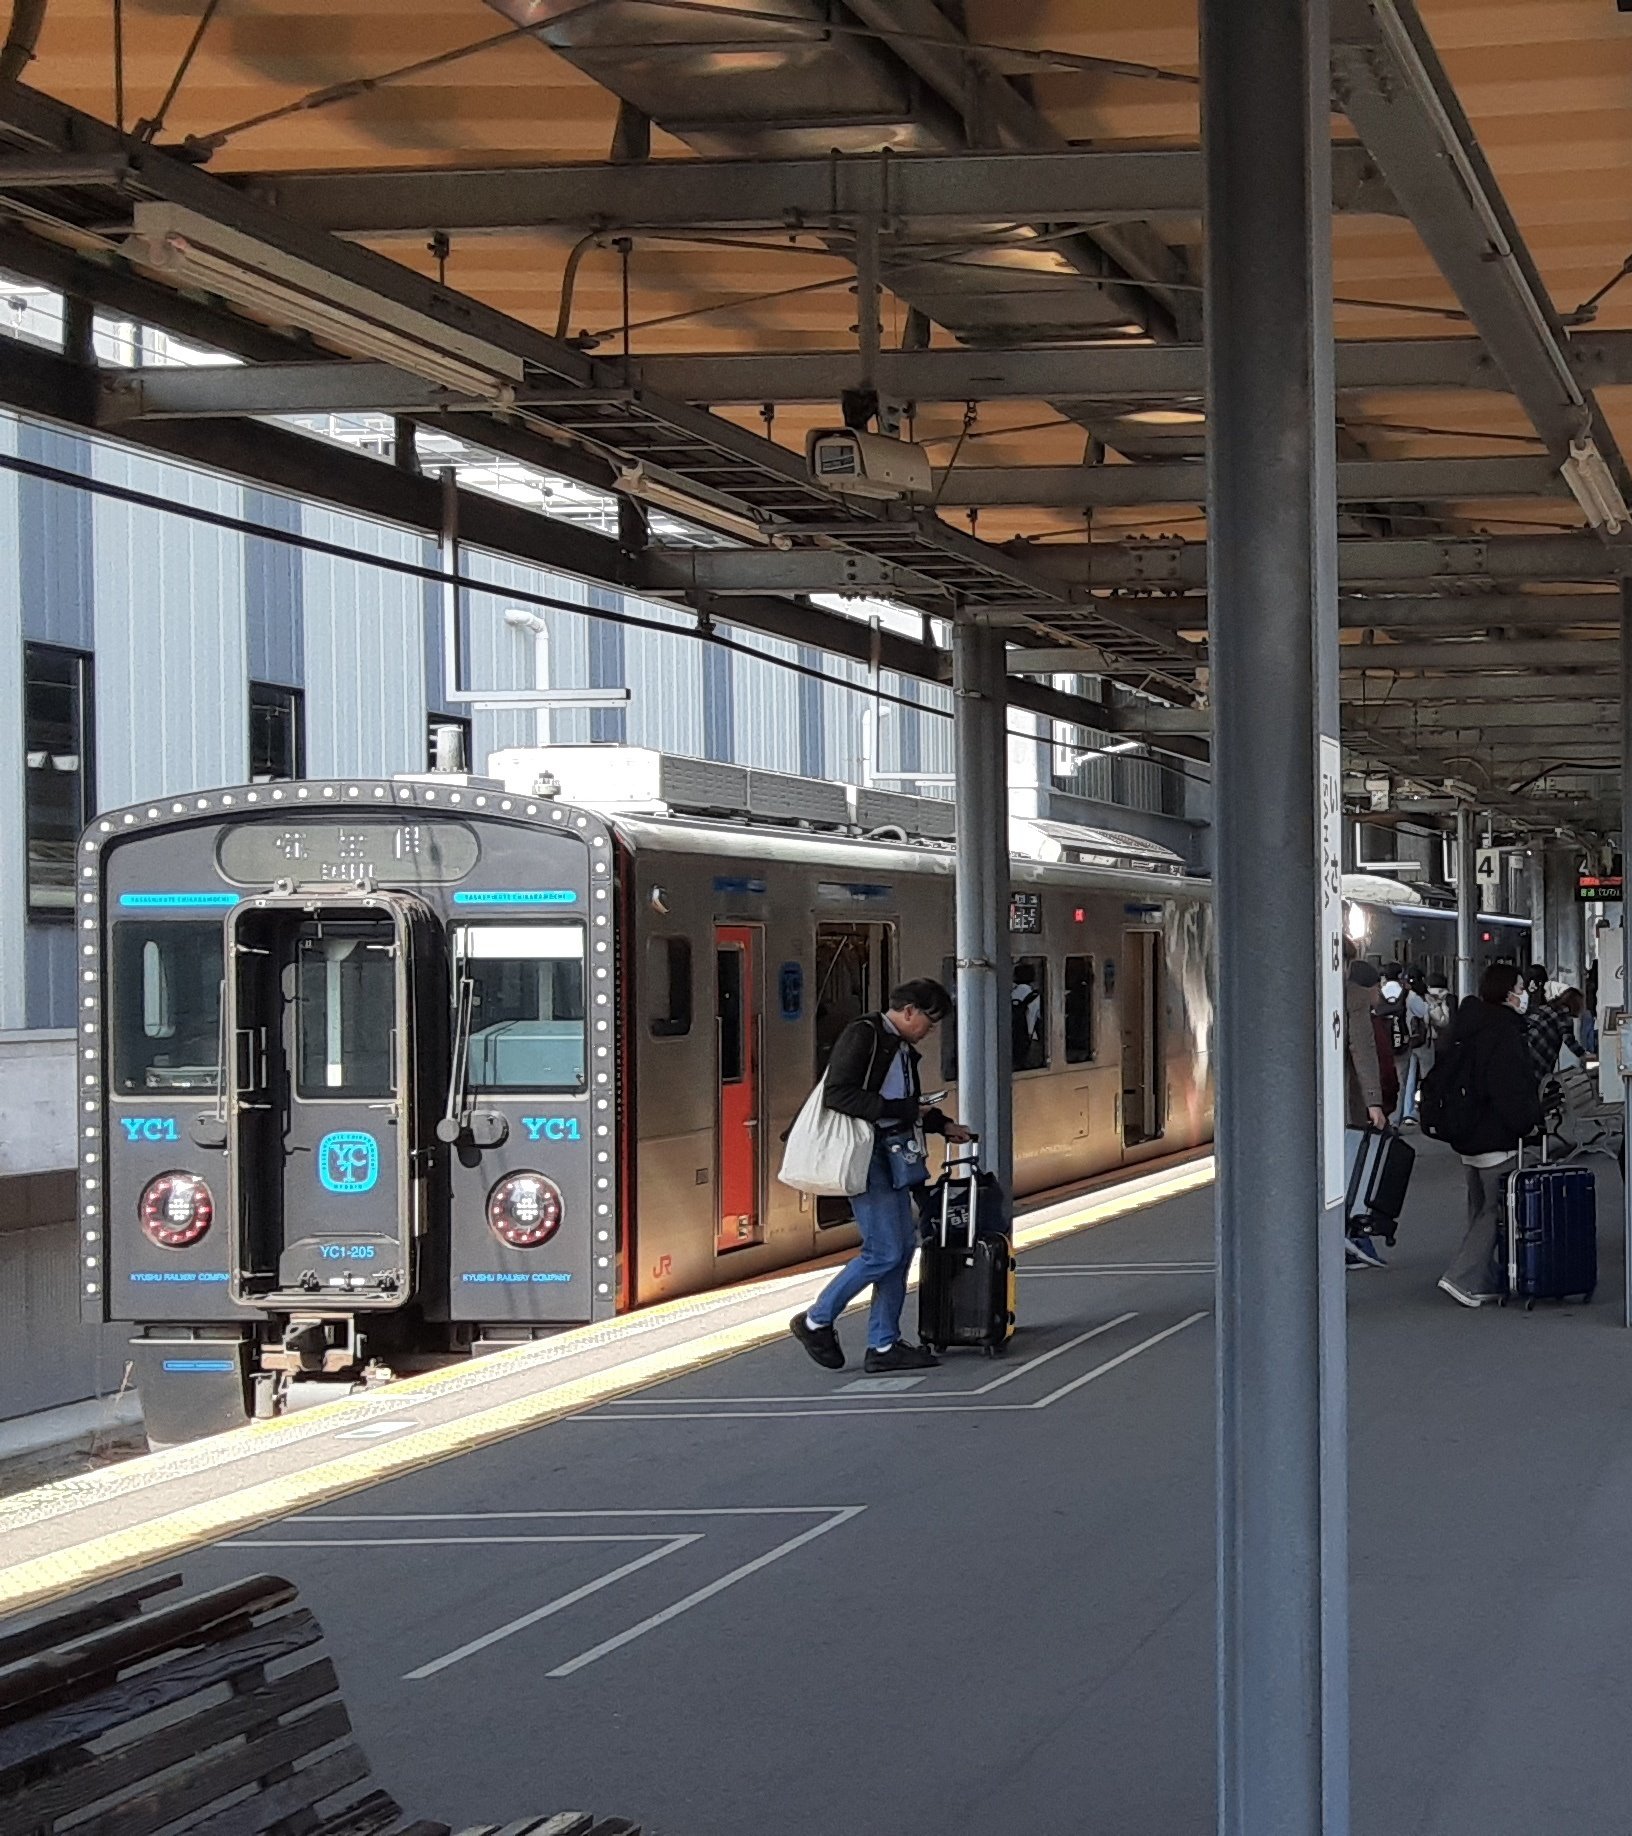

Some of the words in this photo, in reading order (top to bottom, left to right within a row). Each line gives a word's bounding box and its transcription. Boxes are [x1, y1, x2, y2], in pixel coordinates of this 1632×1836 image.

[1478, 855, 1494, 878] 4
[1330, 775, 1340, 1051] いさはや
[120, 1118, 178, 1140] YC1
[522, 1117, 580, 1140] YC1
[319, 1245, 375, 1259] YC1-205
[653, 1254, 672, 1279] JR
